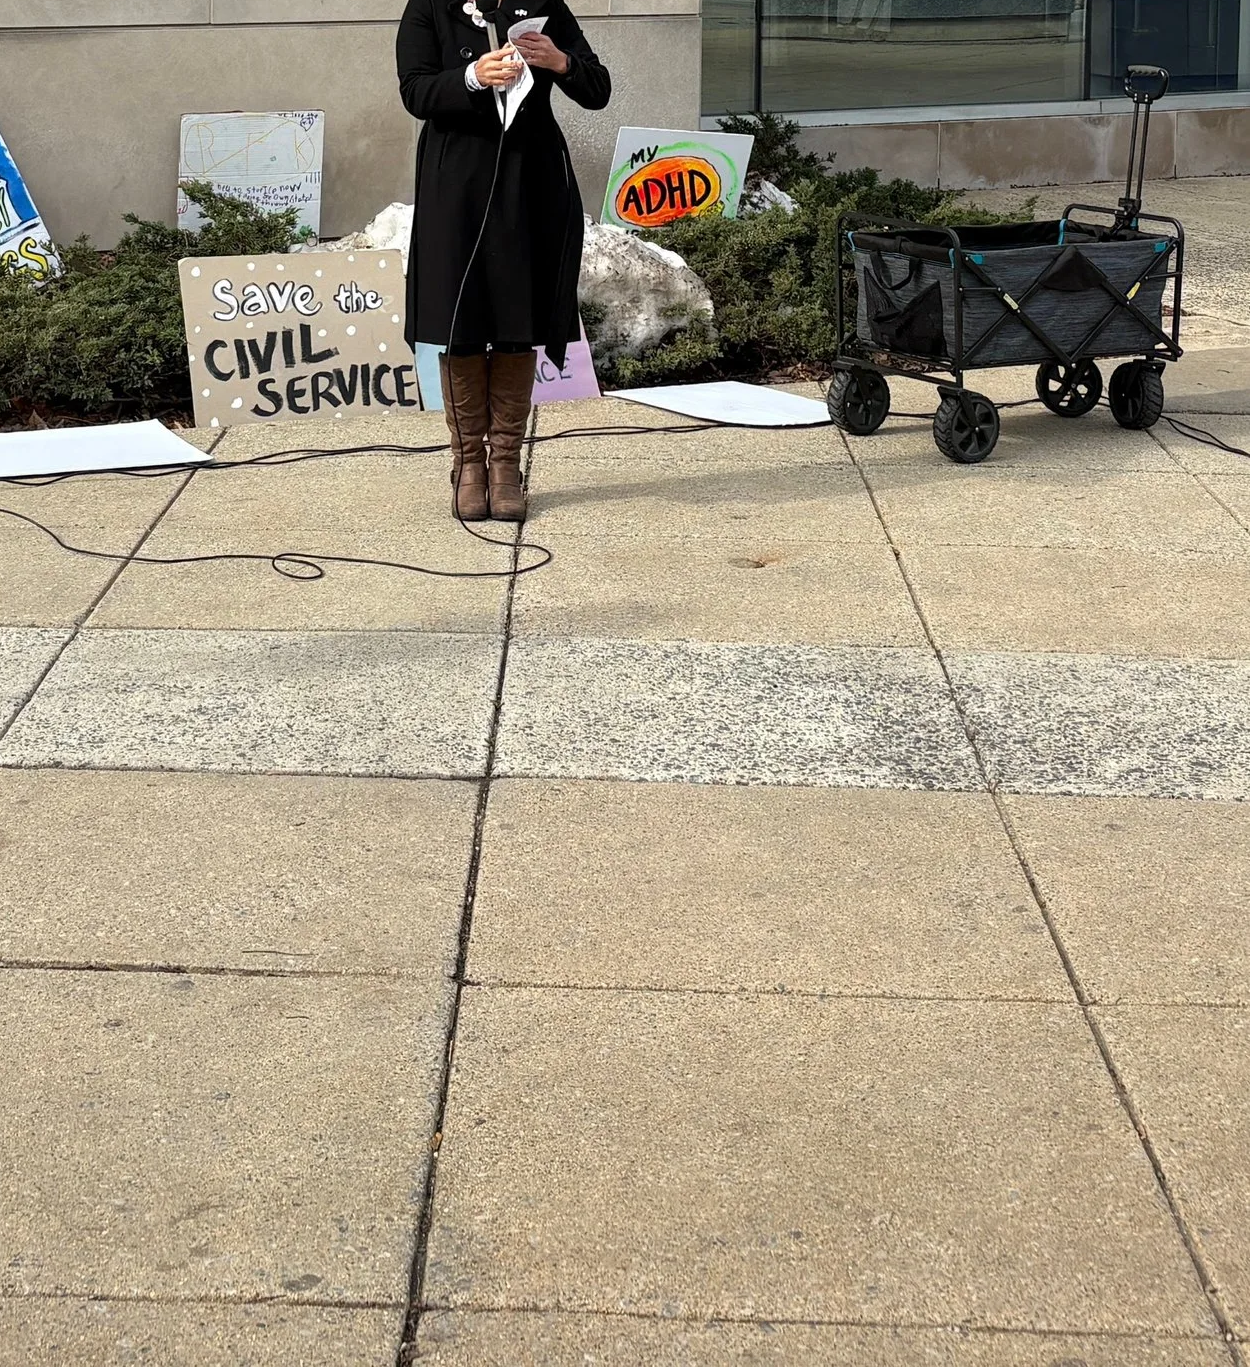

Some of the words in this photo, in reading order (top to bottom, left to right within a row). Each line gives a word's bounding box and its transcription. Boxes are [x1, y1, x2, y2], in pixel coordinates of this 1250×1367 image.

[623, 170, 712, 216] ADHD
[212, 278, 323, 322] Save
[334, 281, 383, 314] the
[204, 323, 340, 382] CIVIL
[250, 362, 417, 417] SERVICE
